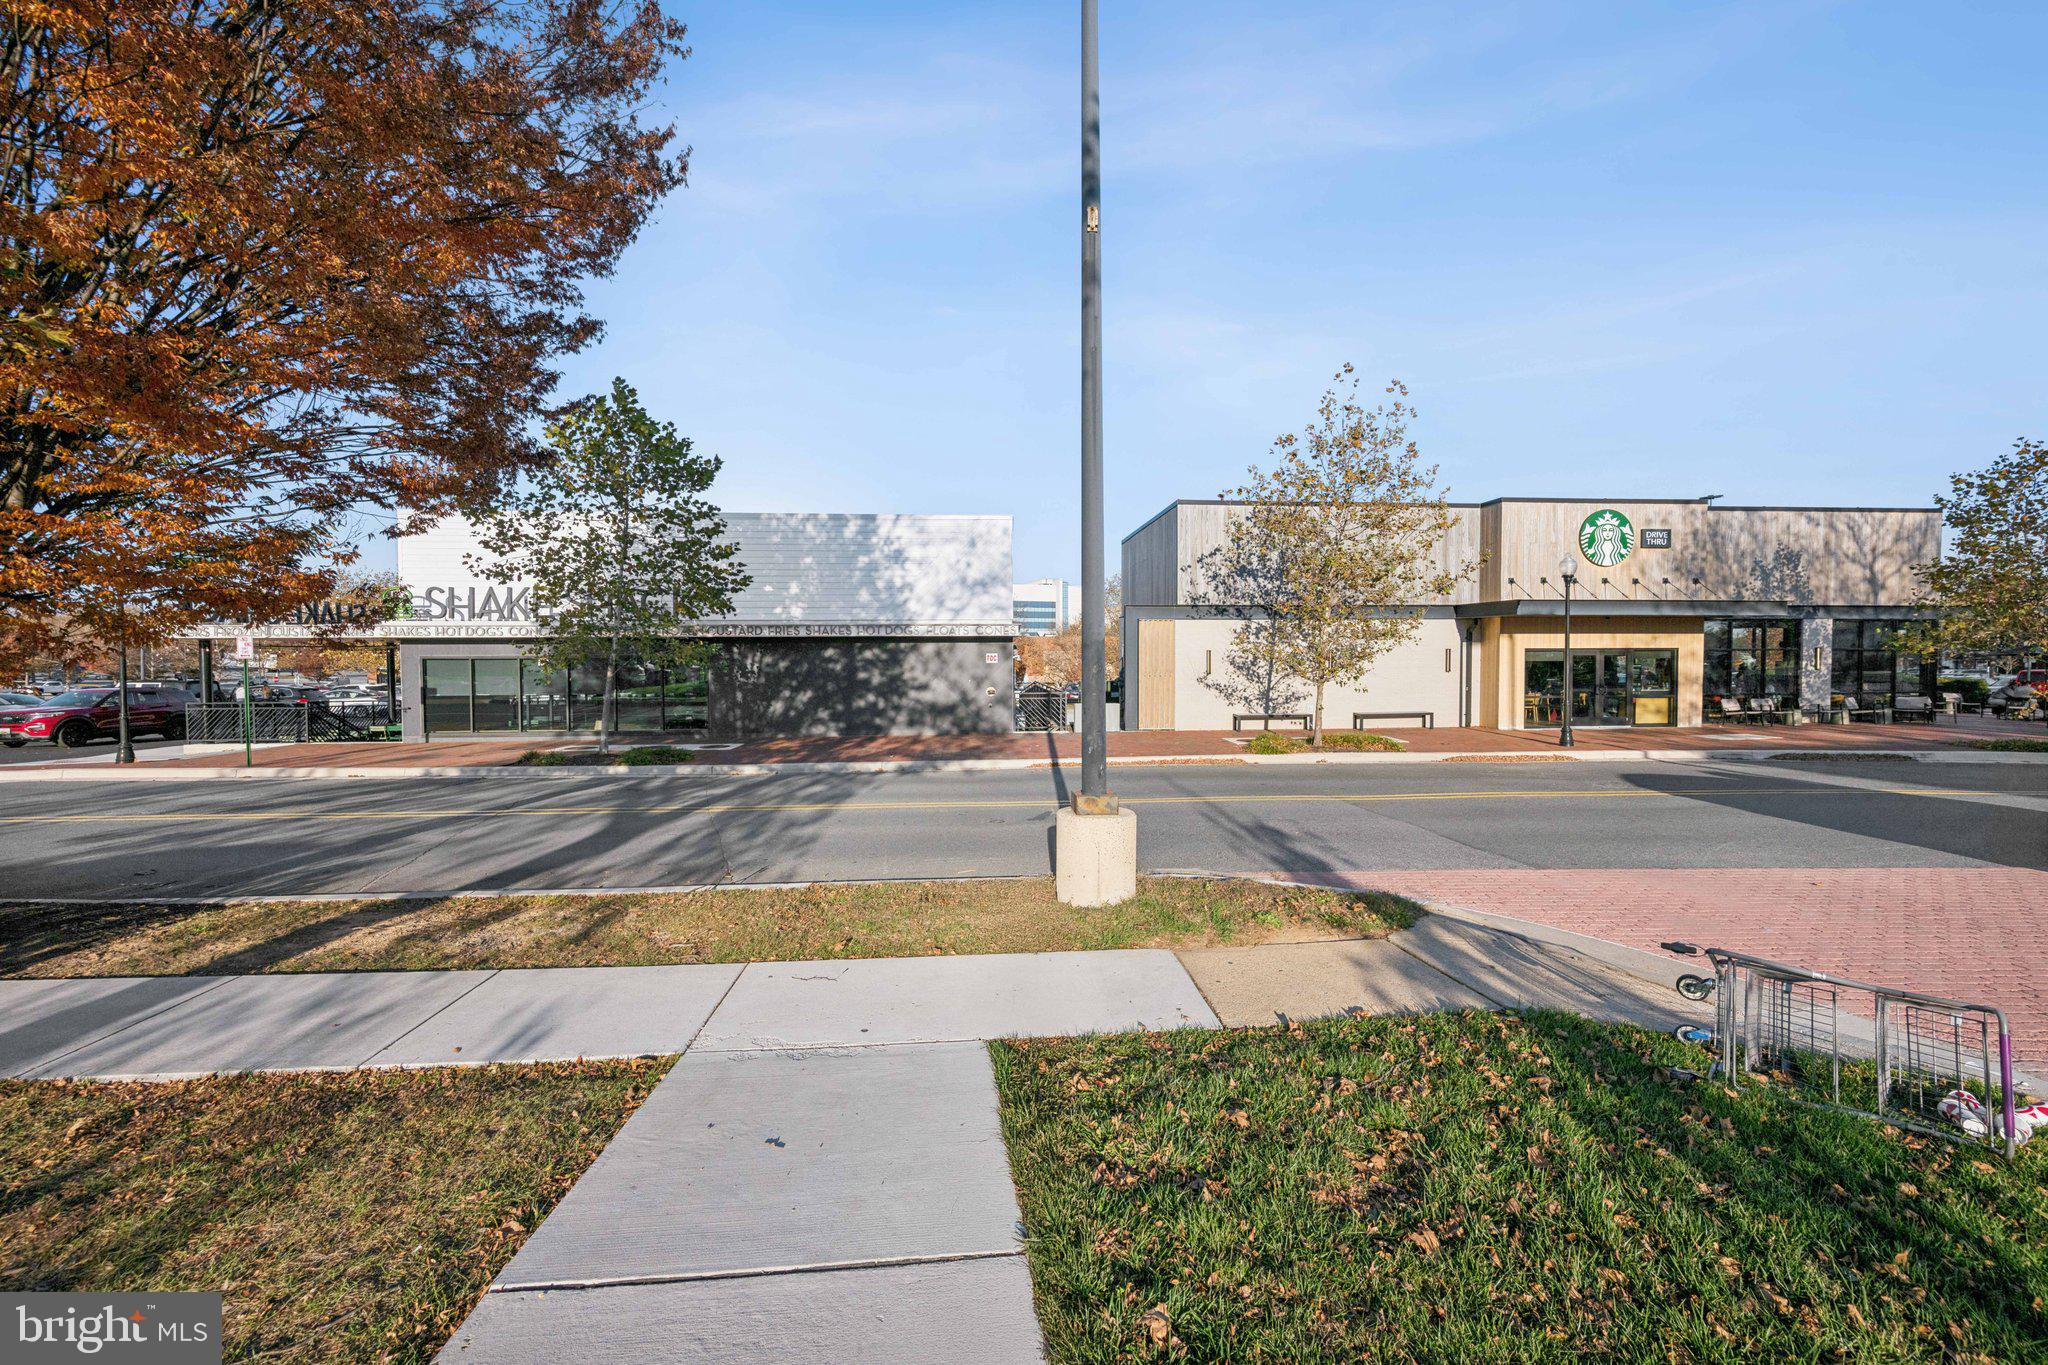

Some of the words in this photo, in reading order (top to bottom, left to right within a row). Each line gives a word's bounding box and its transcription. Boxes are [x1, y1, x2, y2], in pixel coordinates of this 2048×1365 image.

[381, 626, 432, 637] SHAKES
[436, 626, 463, 637] HOT
[465, 626, 504, 637] DOGS
[709, 626, 763, 636] CUSTARD
[767, 626, 801, 636] FRIES
[805, 626, 852, 636] SHAKES
[857, 626, 882, 636] HOT
[885, 626, 920, 636] DOGS
[926, 626, 970, 636] FLOATS
[975, 626, 1017, 636] CONES
